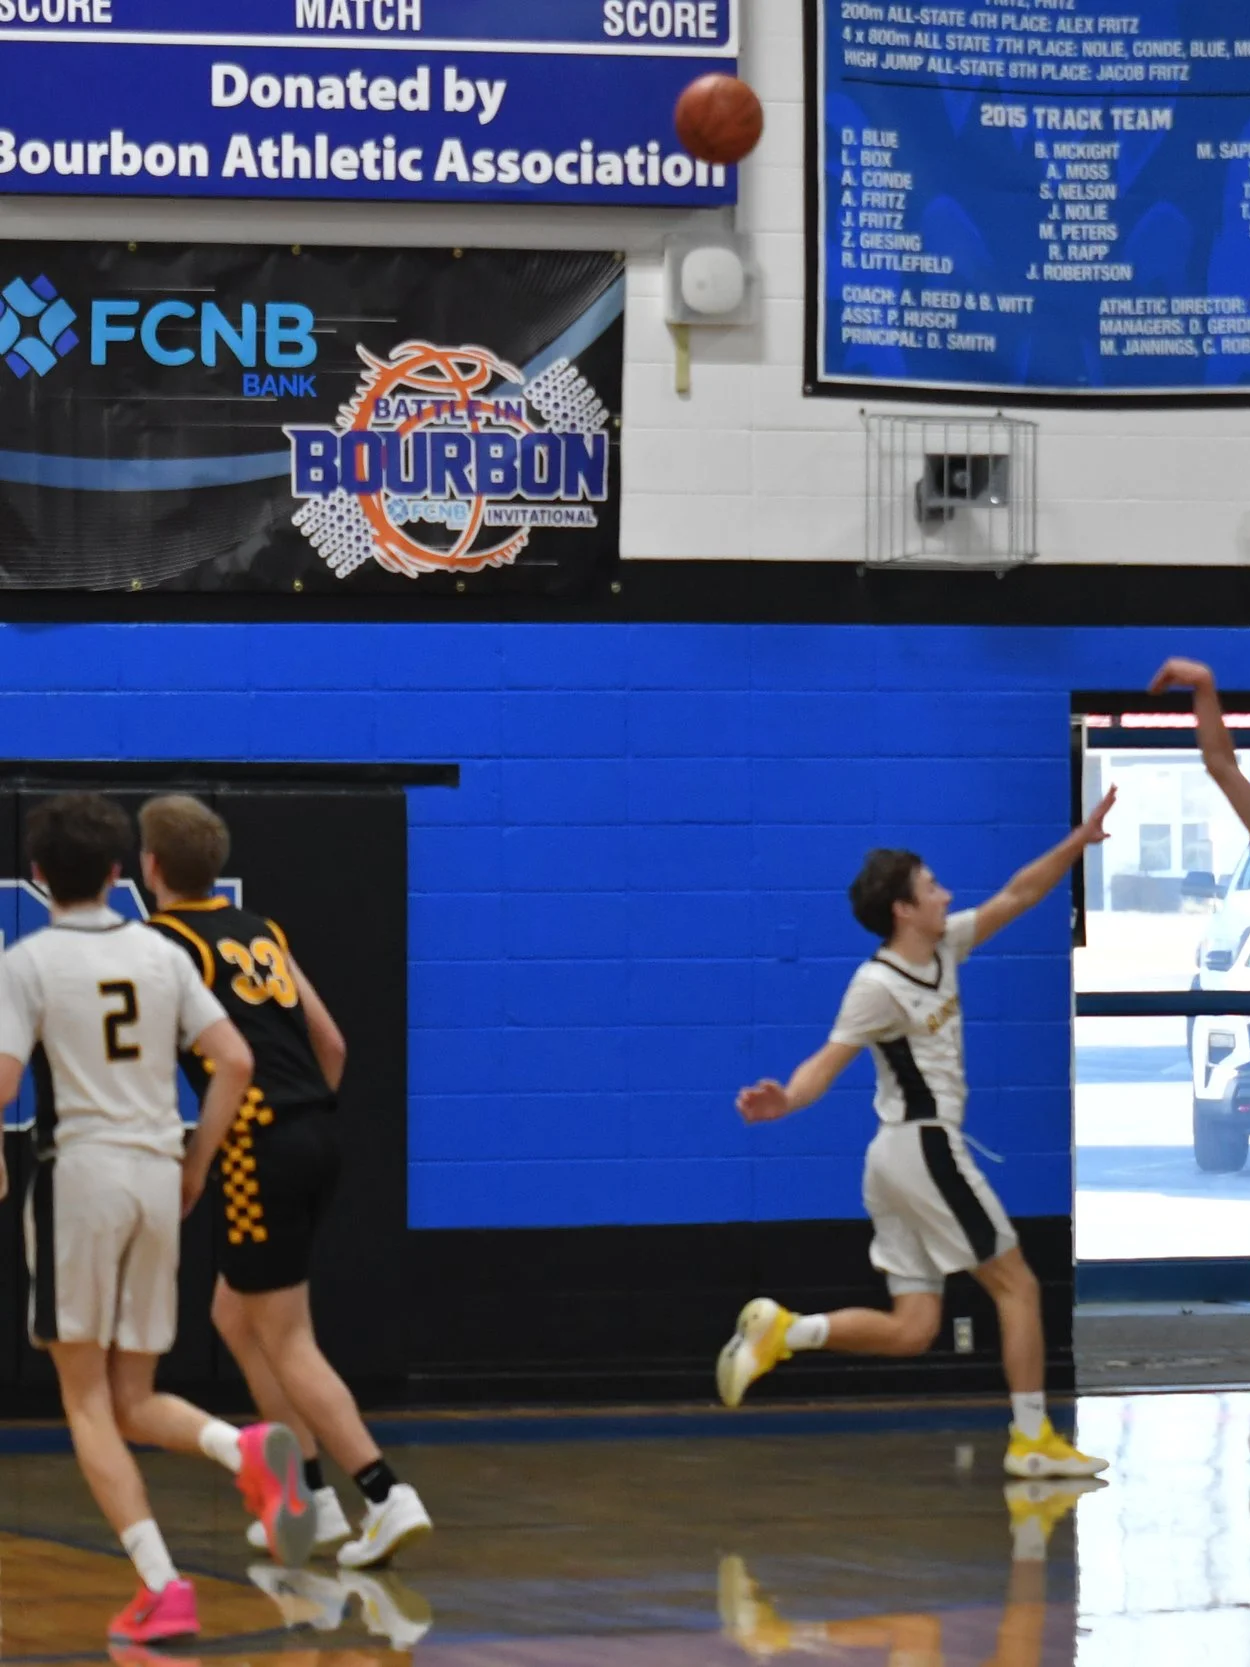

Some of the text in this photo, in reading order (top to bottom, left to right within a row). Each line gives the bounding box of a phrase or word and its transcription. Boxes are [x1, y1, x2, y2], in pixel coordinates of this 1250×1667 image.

[296, 0, 422, 31] MATCH
[603, 1, 718, 38] SCORE
[841, 3, 1139, 34] 200m ALL-STATE 4TH PLACE: ALEX FRITZ
[842, 26, 851, 43] 4
[855, 31, 864, 43] x
[914, 31, 941, 49] ALL
[946, 33, 990, 53] STATE
[995, 38, 1024, 55] 7TH
[1028, 39, 1078, 57] PLACE:
[844, 50, 877, 68] HIGH
[881, 52, 924, 71] JUMP
[927, 57, 1005, 77] ALL-STATE
[1041, 63, 1092, 81] PLACE:
[1096, 64, 1145, 81] JACOB
[1149, 65, 1189, 81] FRITZ
[211, 62, 506, 124] Donated by
[980, 104, 1173, 130] 2015 TRACK TEAM
[223, 134, 423, 183] Athletic
[433, 138, 726, 187] Association
[842, 150, 892, 167] L. BOX
[1053, 144, 1119, 160] MCKIGHT
[842, 172, 912, 190] A. CONDE
[1047, 163, 1110, 179] A. MOSS
[842, 192, 905, 210] A. FRITZ
[1058, 184, 1116, 200] NELSON
[842, 211, 903, 230] J. FRITZ
[1065, 205, 1107, 221] NOLIE
[842, 232, 922, 251] Z. GIESING
[1062, 224, 1118, 241] PETERS
[861, 253, 953, 274] LITTLEFIELD
[1068, 245, 1110, 261] RAPP
[1044, 265, 1133, 281] ROBERTSON
[1100, 297, 1167, 314] ATHLETIC
[91, 300, 317, 368] FCNB
[842, 327, 923, 348] PRINCIPAL:
[947, 334, 995, 351] SMITH
[243, 373, 316, 397] BANK
[373, 398, 522, 421] BATTLE IN
[288, 428, 606, 496] BOURBON
[409, 503, 467, 519] FCNB
[487, 509, 594, 523] INVITATIONAL
[217, 937, 297, 1008] 33
[98, 980, 141, 1062] 2
